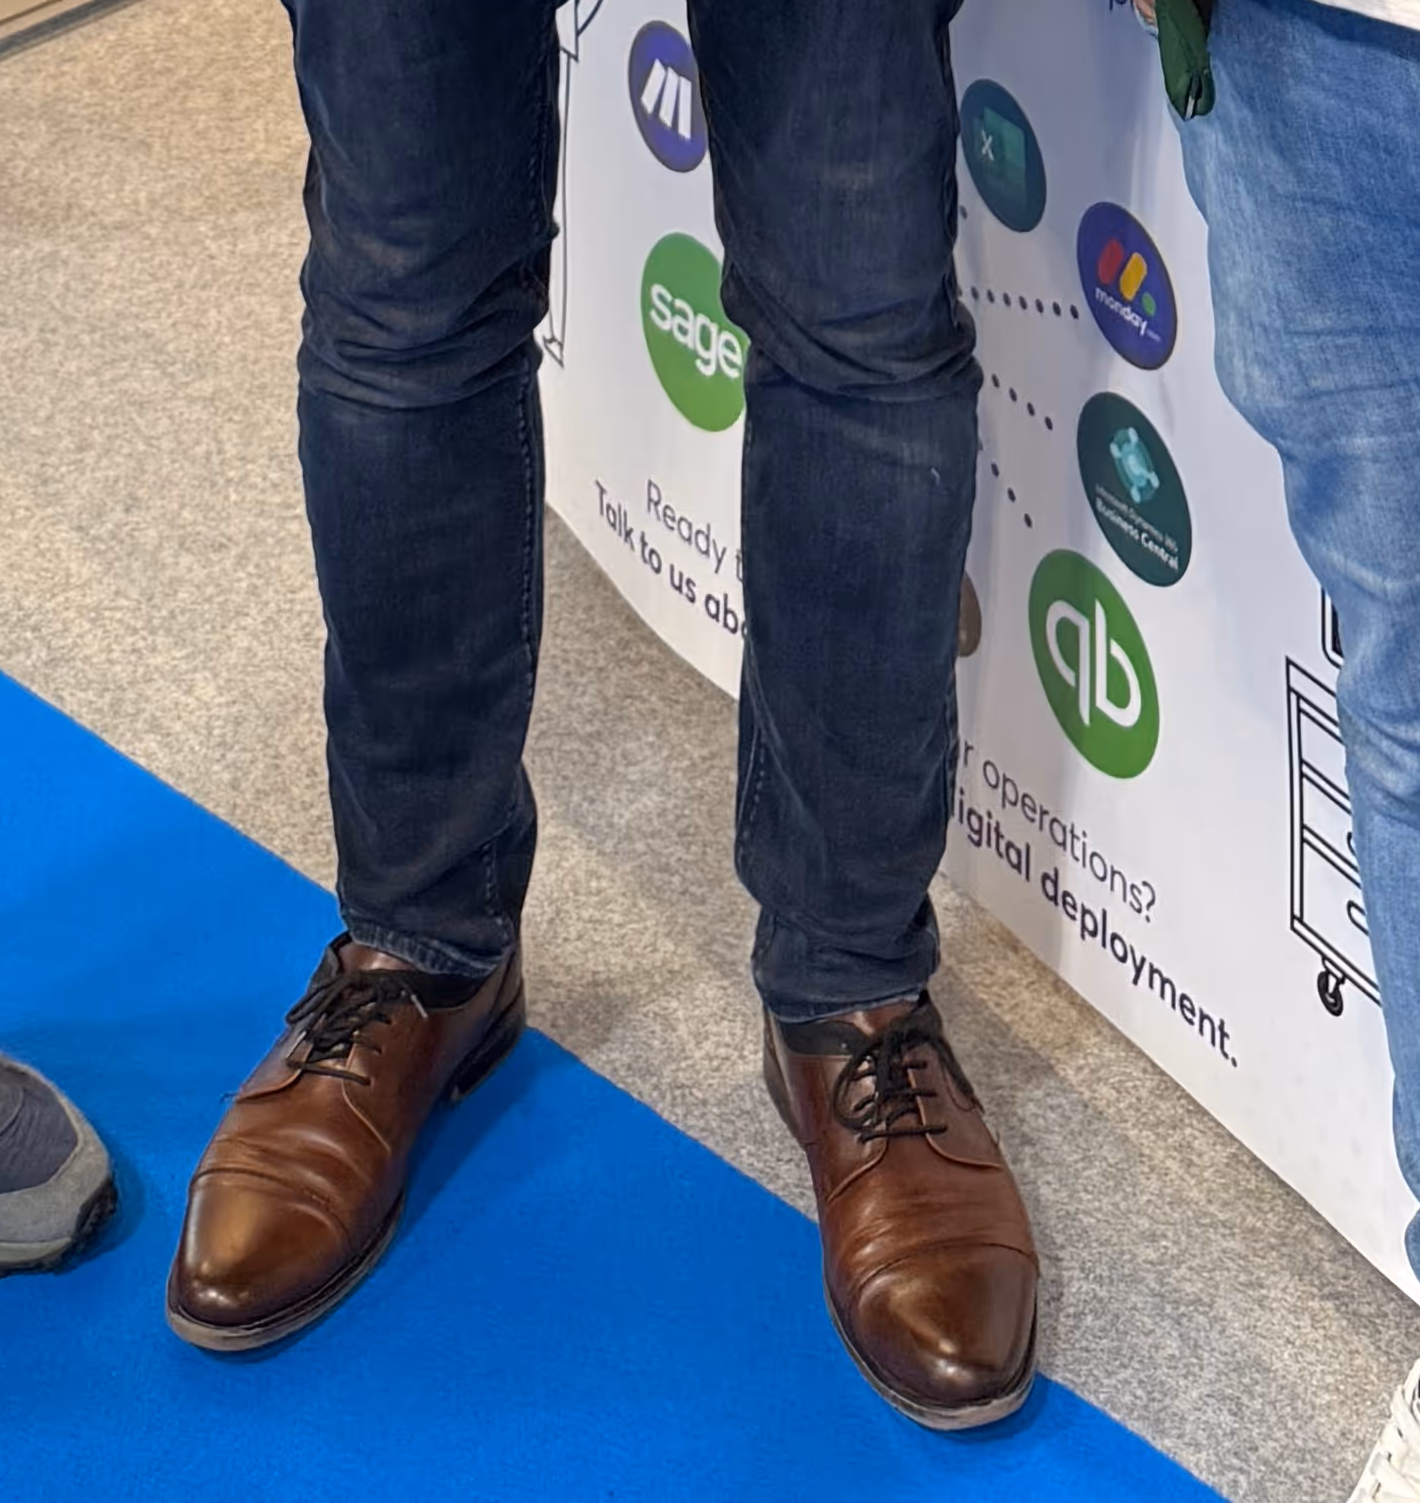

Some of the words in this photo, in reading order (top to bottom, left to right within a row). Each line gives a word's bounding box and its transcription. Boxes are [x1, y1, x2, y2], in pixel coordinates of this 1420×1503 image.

[650, 281, 744, 380] sage
[595, 479, 635, 552] Talk
[640, 531, 662, 575] to
[669, 564, 697, 604] us
[647, 479, 727, 575] Ready
[1141, 532, 1179, 571] Central
[982, 759, 1155, 924] operations?
[958, 786, 1031, 883] igital
[1041, 867, 1240, 1068] deployment.
